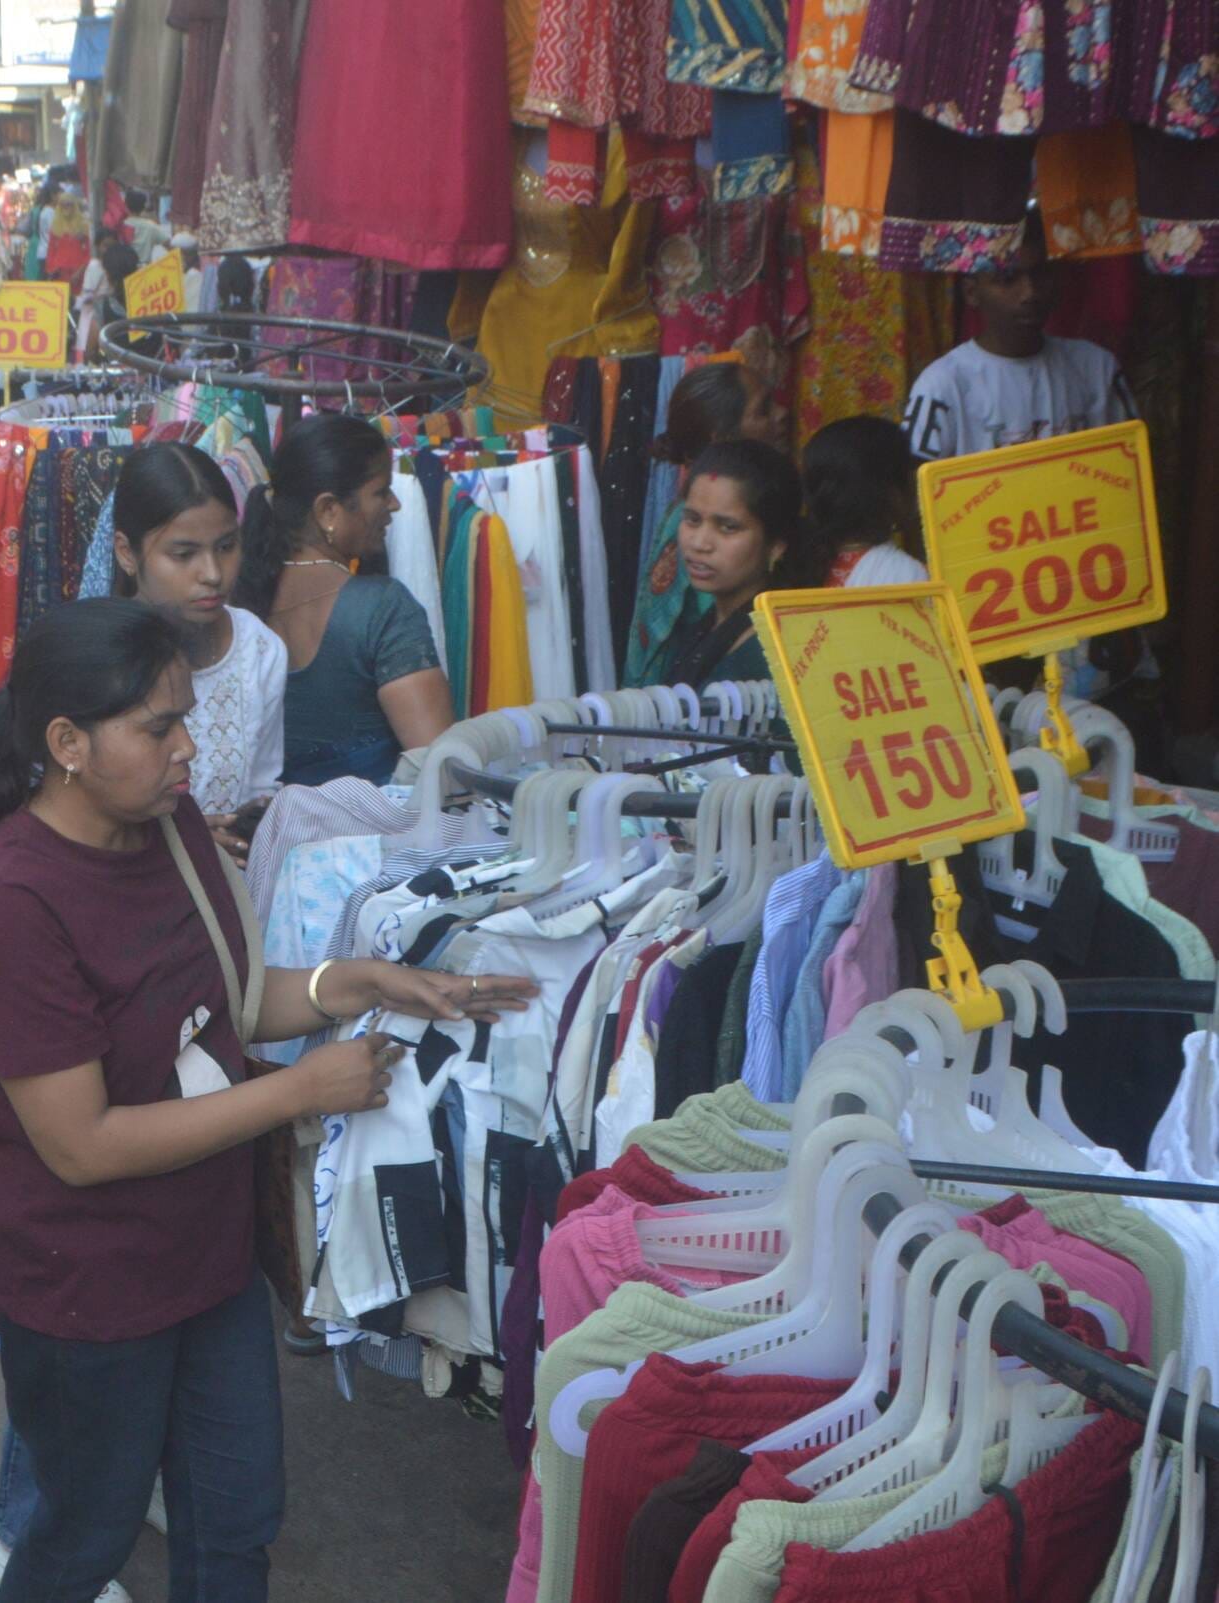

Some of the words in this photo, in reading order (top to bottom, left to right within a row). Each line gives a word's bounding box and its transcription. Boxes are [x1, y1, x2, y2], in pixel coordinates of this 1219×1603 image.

[141, 276, 169, 300] SALE
[1069, 461, 1090, 476] FIX
[1092, 469, 1132, 490] PRICE
[941, 510, 964, 533] FIX
[964, 478, 1003, 514] PRICE
[987, 497, 1100, 554] SALE
[964, 542, 1128, 632] 200
[803, 619, 830, 663] PRICE
[832, 662, 929, 721] SALE
[843, 724, 973, 820] 150
